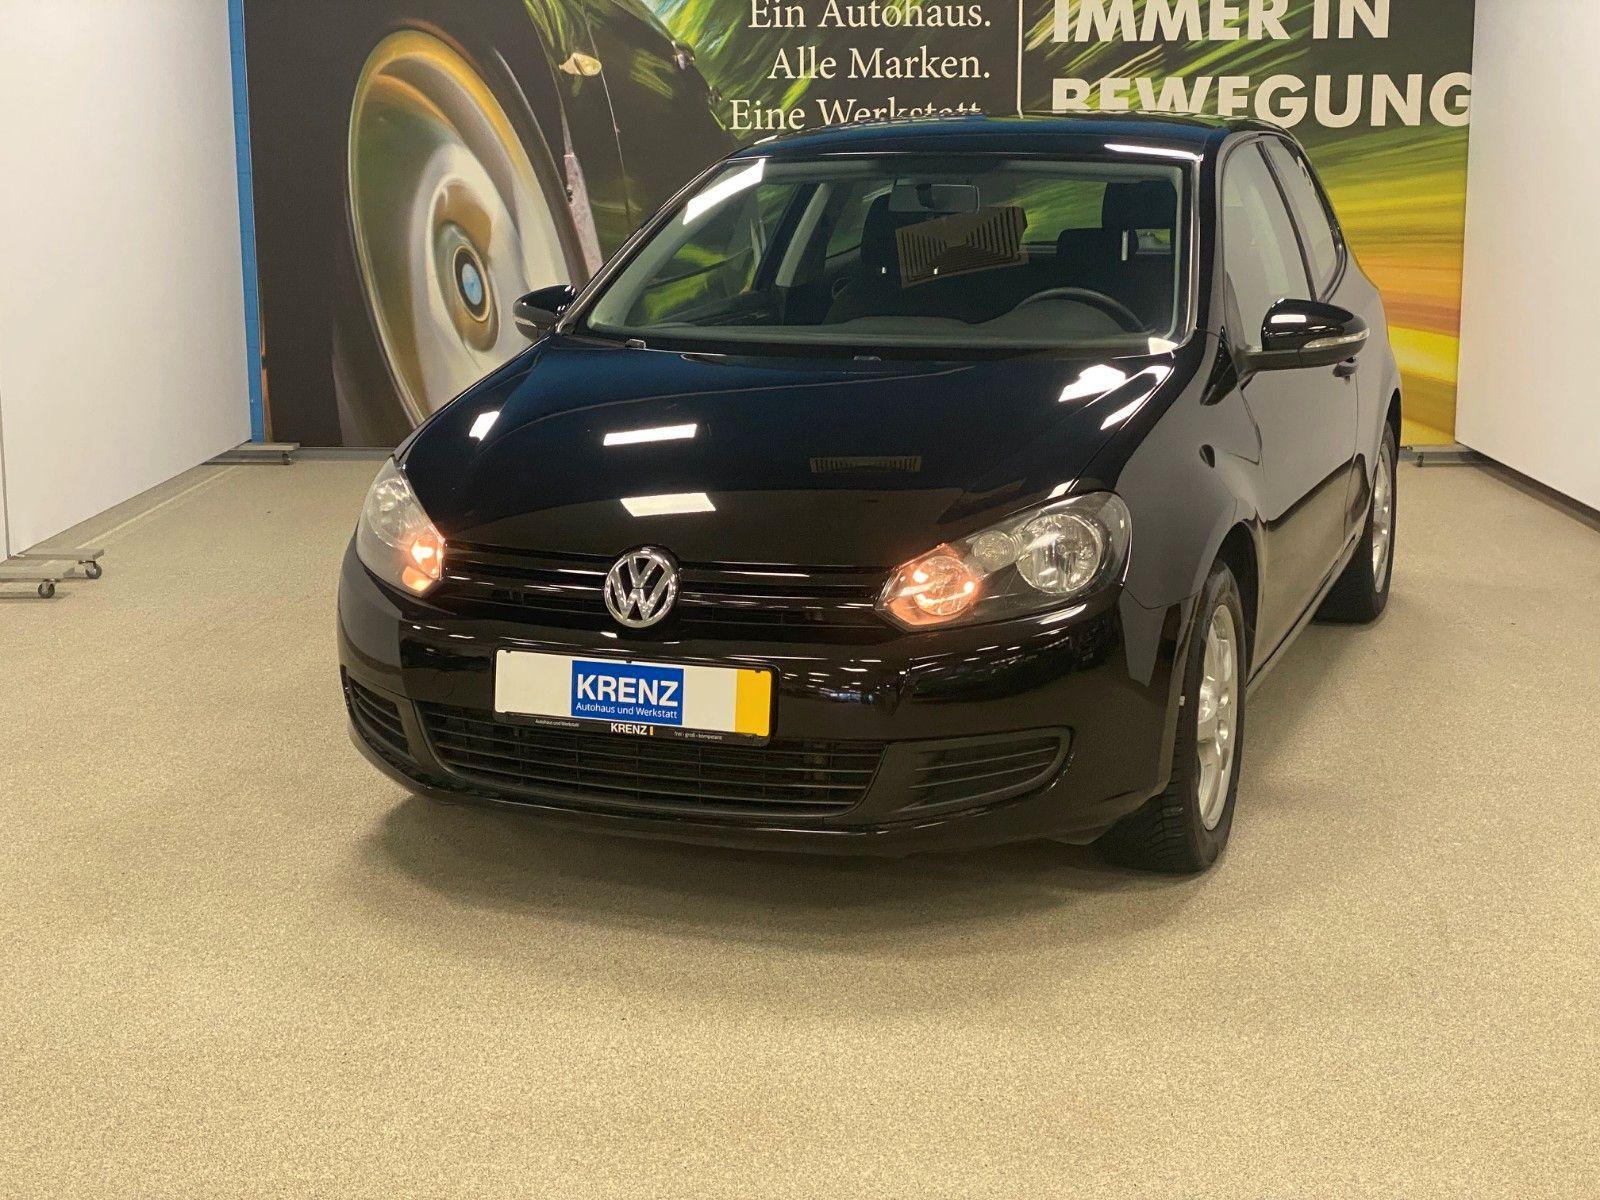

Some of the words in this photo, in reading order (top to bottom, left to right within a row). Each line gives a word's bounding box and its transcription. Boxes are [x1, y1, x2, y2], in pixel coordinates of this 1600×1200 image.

[748, 0, 806, 28] Ein
[817, 0, 991, 28] Autohaus.
[1053, 0, 1290, 42] IMMER
[1312, 0, 1390, 40] IN
[766, 45, 837, 79] Alle
[847, 45, 990, 79] Marken.
[729, 99, 805, 130] Eine
[577, 673, 679, 707] KRENZ
[575, 702, 616, 714] Autohaus
[617, 706, 634, 715] und
[636, 707, 678, 719] Werkstatt
[610, 722, 648, 736] KRENZ
